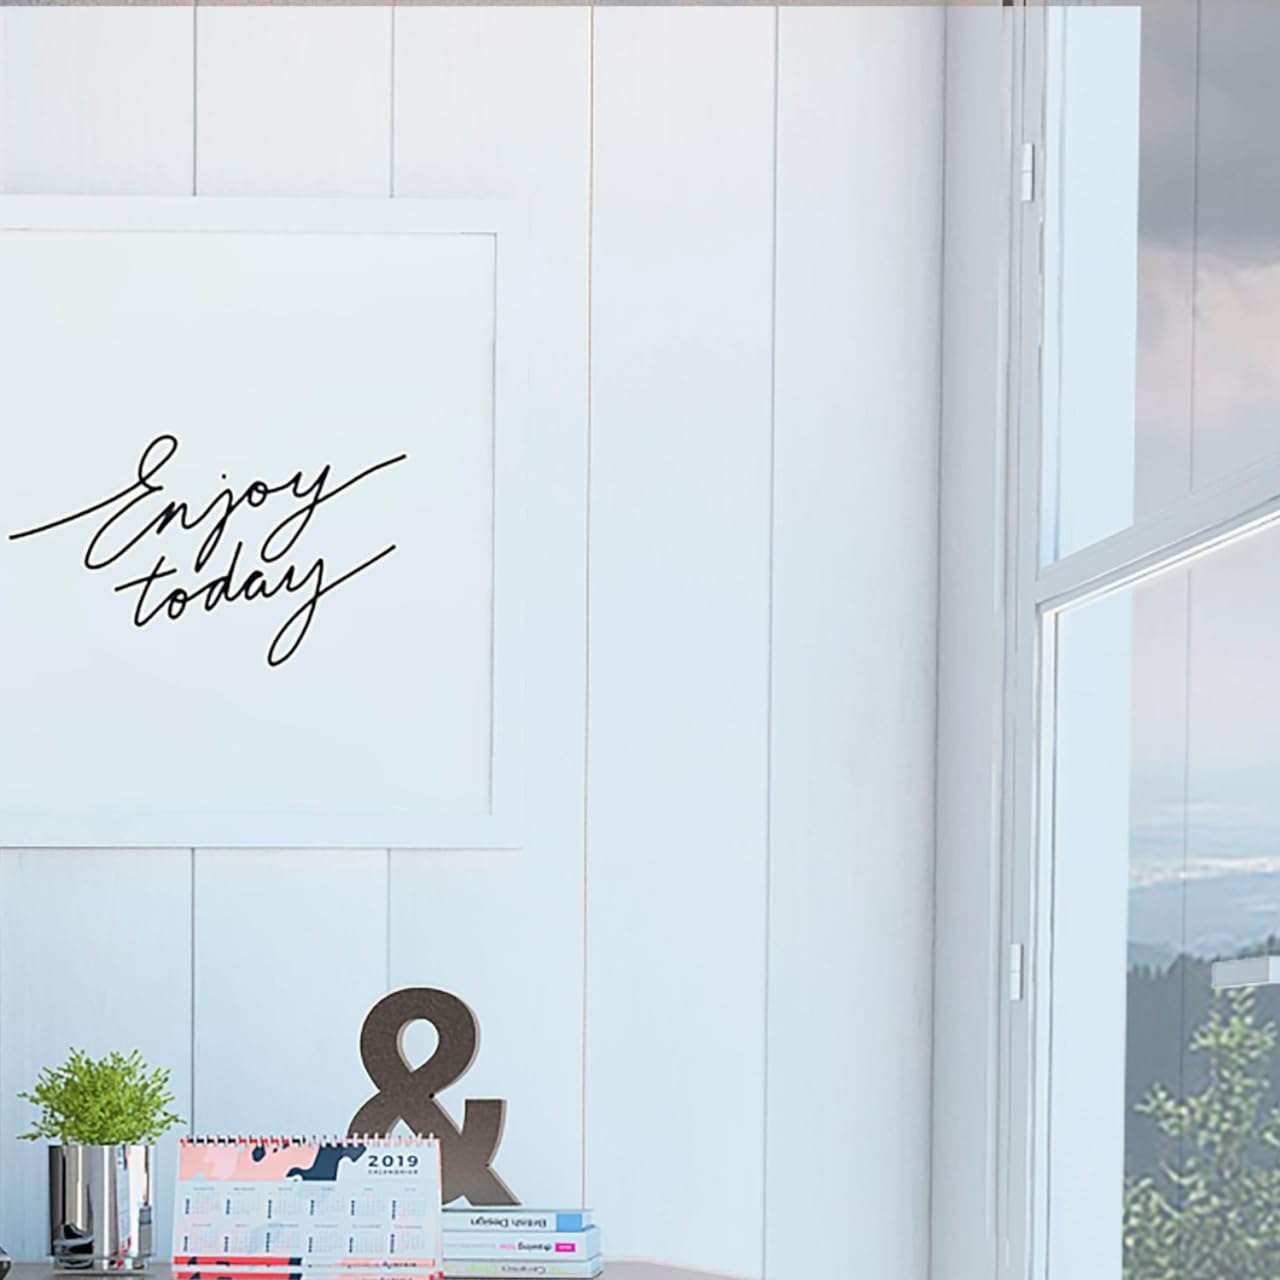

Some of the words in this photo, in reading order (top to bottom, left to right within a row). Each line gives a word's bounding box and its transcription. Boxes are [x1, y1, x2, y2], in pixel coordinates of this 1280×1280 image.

[9, 435, 406, 572] Enjoy
[115, 541, 396, 666] today
[368, 1155, 419, 1167] 2019
[470, 1216, 509, 1228] Design
